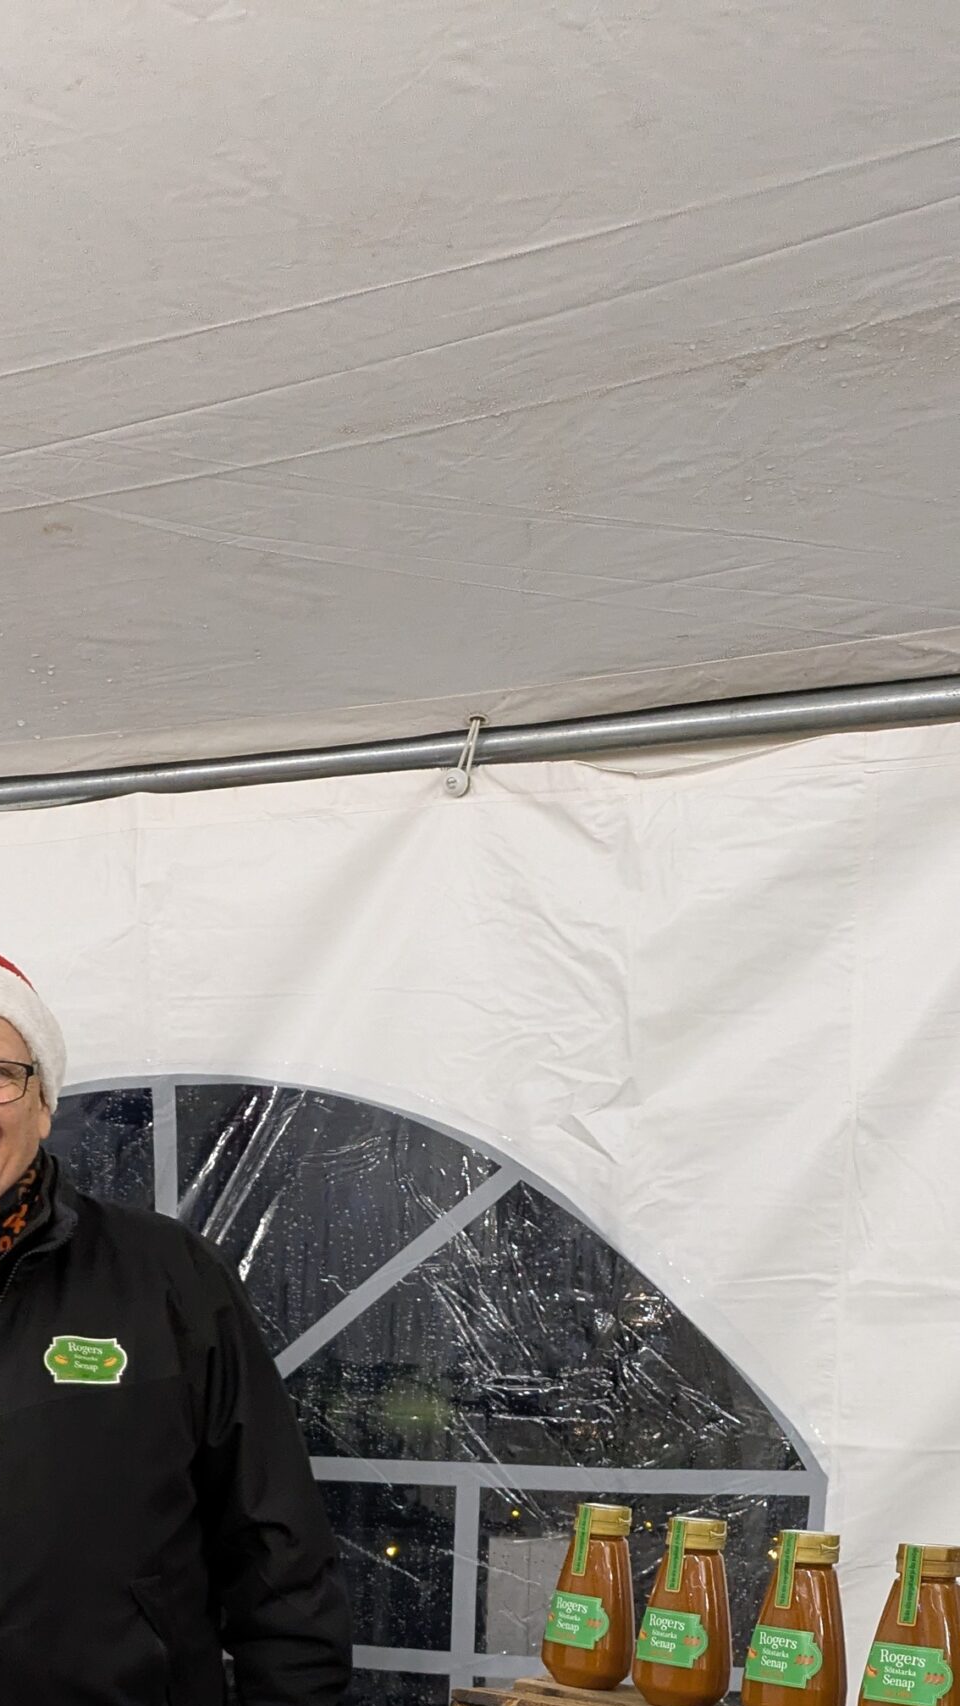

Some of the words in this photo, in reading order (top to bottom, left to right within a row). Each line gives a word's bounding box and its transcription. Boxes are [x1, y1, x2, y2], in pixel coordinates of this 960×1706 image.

[68, 1342, 102, 1355] Rogers
[556, 1597, 587, 1614] Rogers
[557, 1619, 579, 1633] Senap
[649, 1614, 685, 1631] Rogers
[650, 1636, 675, 1652] Senap
[759, 1632, 798, 1649] Rogers
[760, 1656, 788, 1671] Senap
[880, 1649, 926, 1668] Rogers
[882, 1674, 914, 1691] Senap
